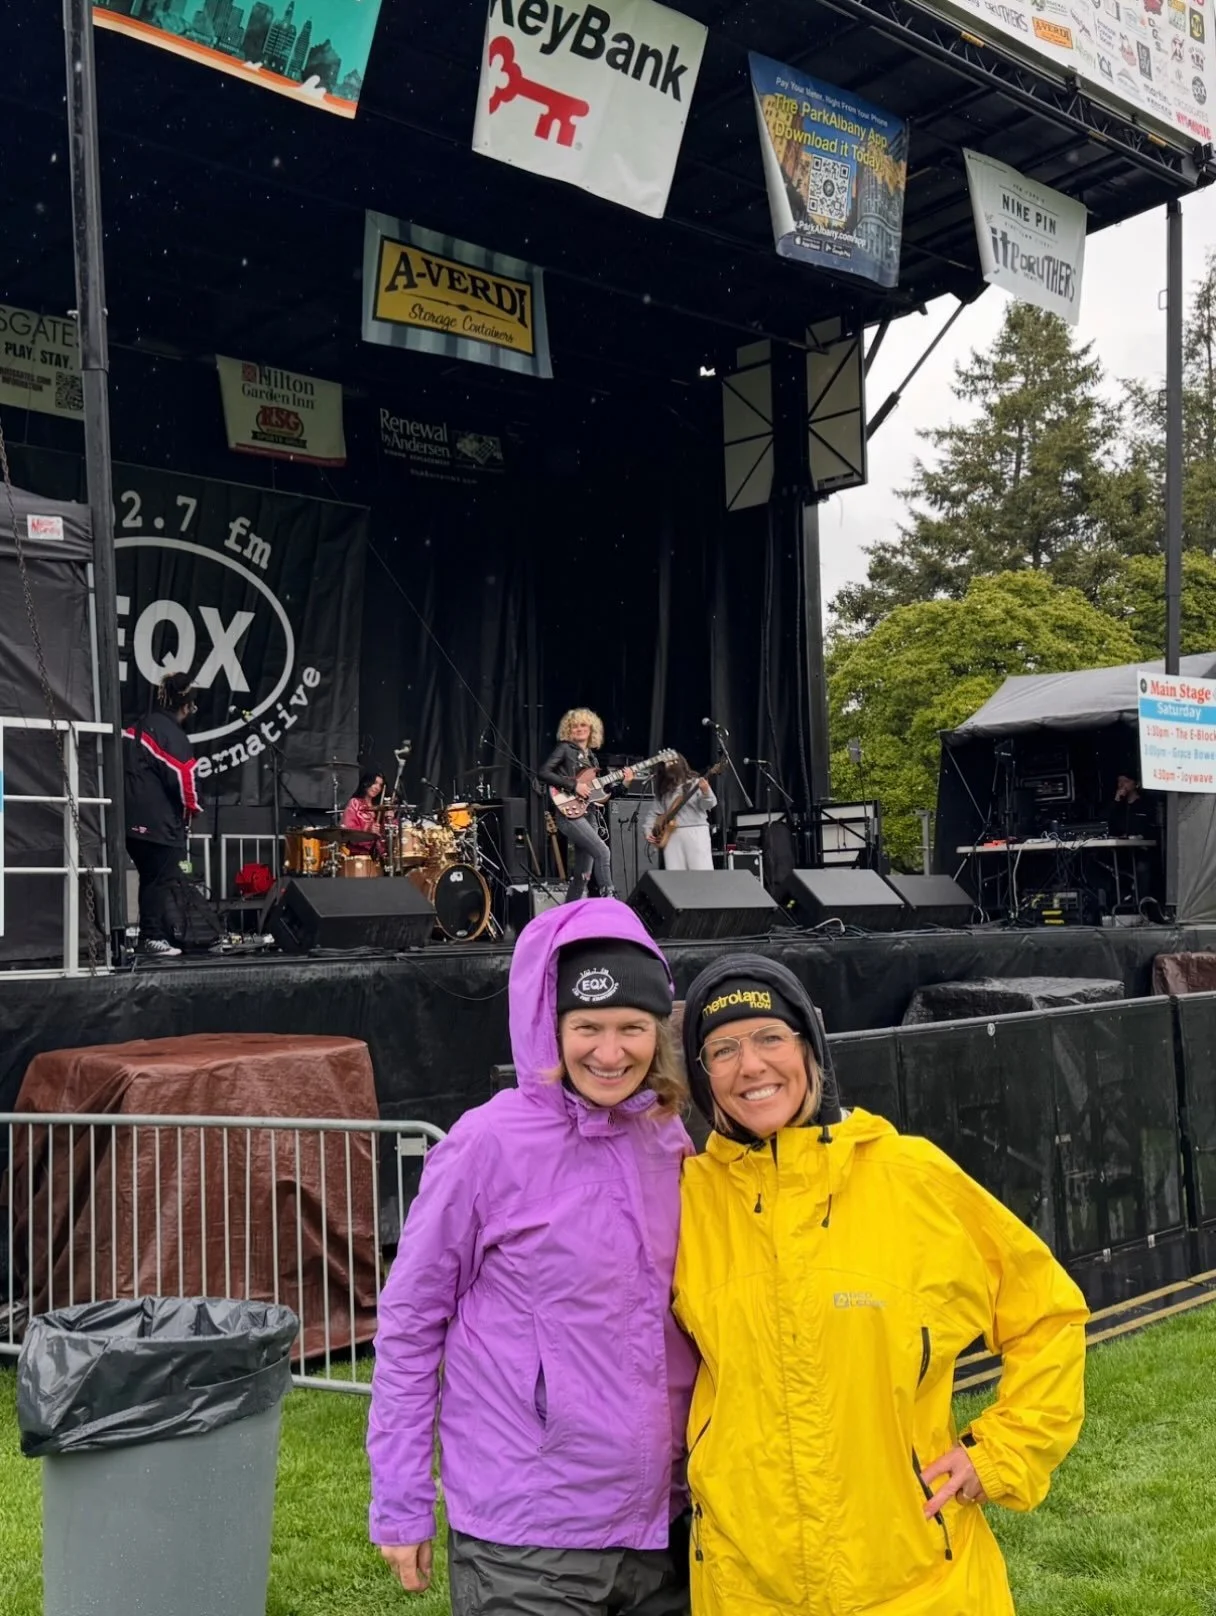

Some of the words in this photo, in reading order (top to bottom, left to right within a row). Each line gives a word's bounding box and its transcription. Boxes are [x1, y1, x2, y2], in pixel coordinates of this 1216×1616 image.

[775, 76, 789, 90] Pay
[790, 81, 805, 94] Your
[841, 102, 857, 114] From
[857, 108, 871, 119] Your
[871, 114, 889, 128] Phone
[774, 93, 798, 114] The
[802, 102, 866, 141] ParkAlbany
[868, 128, 888, 148] App
[775, 121, 839, 153] Download
[841, 138, 849, 157] it
[1002, 193, 1030, 223] NINE
[1035, 211, 1057, 235] PIN
[990, 226, 1020, 274] ite
[384, 251, 529, 329] A-VERDI
[408, 303, 458, 331] Storage
[462, 315, 515, 344] Containers
[5, 341, 37, 363] PLAY.
[40, 350, 73, 371] STAY.
[241, 382, 290, 406] Garden
[292, 393, 315, 410] Inn
[260, 364, 315, 397] Hilton
[379, 407, 449, 443] Renewal
[391, 432, 452, 459] Andersen
[112, 490, 197, 532] 2.7
[224, 516, 272, 570] fm
[1150, 679, 1177, 697] Main
[1179, 683, 1212, 704] Stage
[197, 666, 321, 779] ernative
[1156, 701, 1201, 721] Saturday
[1176, 726, 1188, 741] The
[582, 977, 608, 991] EQX
[703, 989, 771, 1018] metroland
[750, 1001, 771, 1010] now
